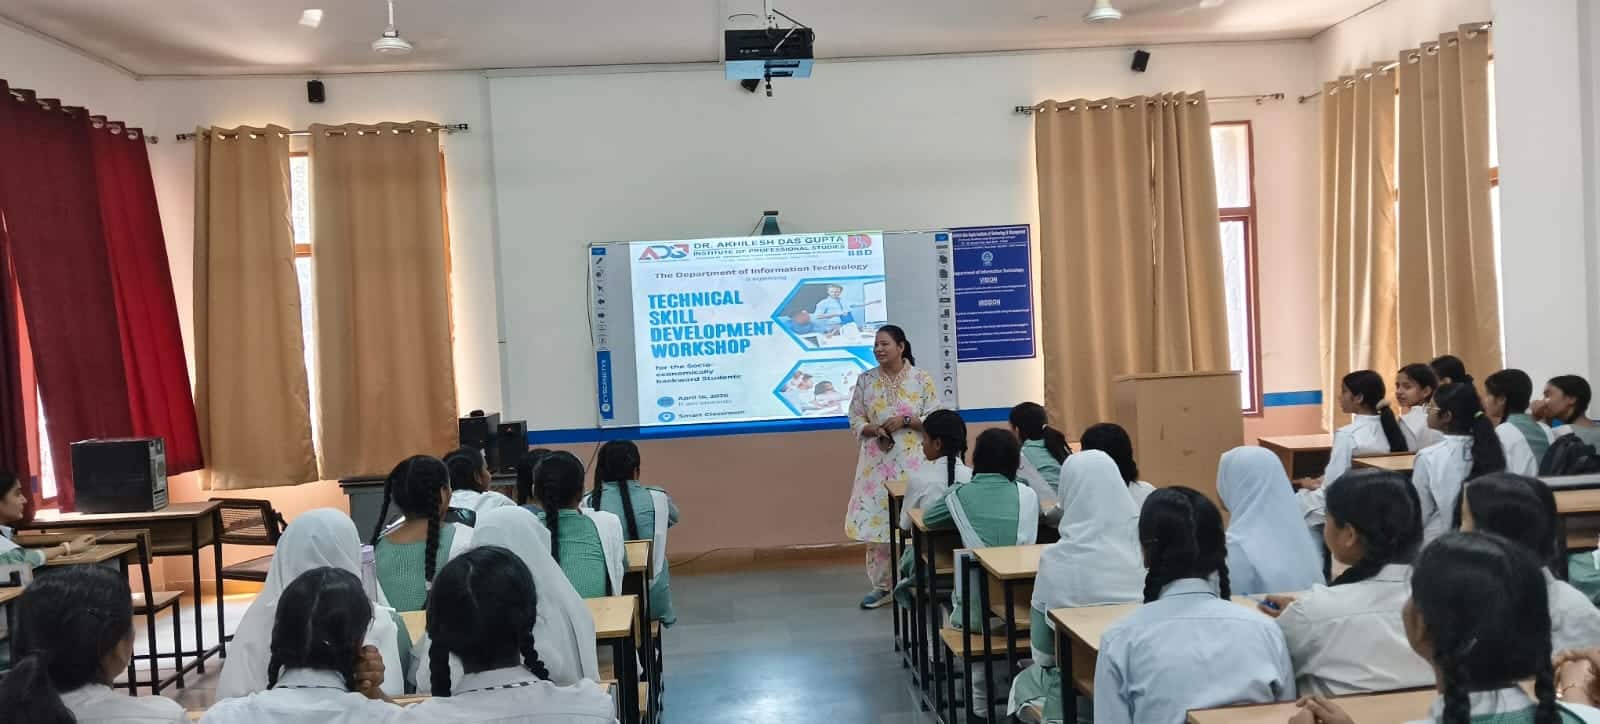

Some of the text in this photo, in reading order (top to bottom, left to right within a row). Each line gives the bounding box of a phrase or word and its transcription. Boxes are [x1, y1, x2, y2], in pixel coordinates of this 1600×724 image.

[717, 240, 774, 248] AKHILESH
[805, 236, 844, 244] GUPTA
[676, 269, 736, 278] Department
[751, 265, 809, 274] Information
[813, 263, 868, 271] Technology
[648, 290, 744, 309] TECHNICAL
[649, 309, 698, 325] SKILL
[650, 321, 774, 342] DEVELOPMENT
[651, 338, 751, 359] WORKSHOP
[656, 369, 714, 377] economically
[656, 376, 700, 384] backward
